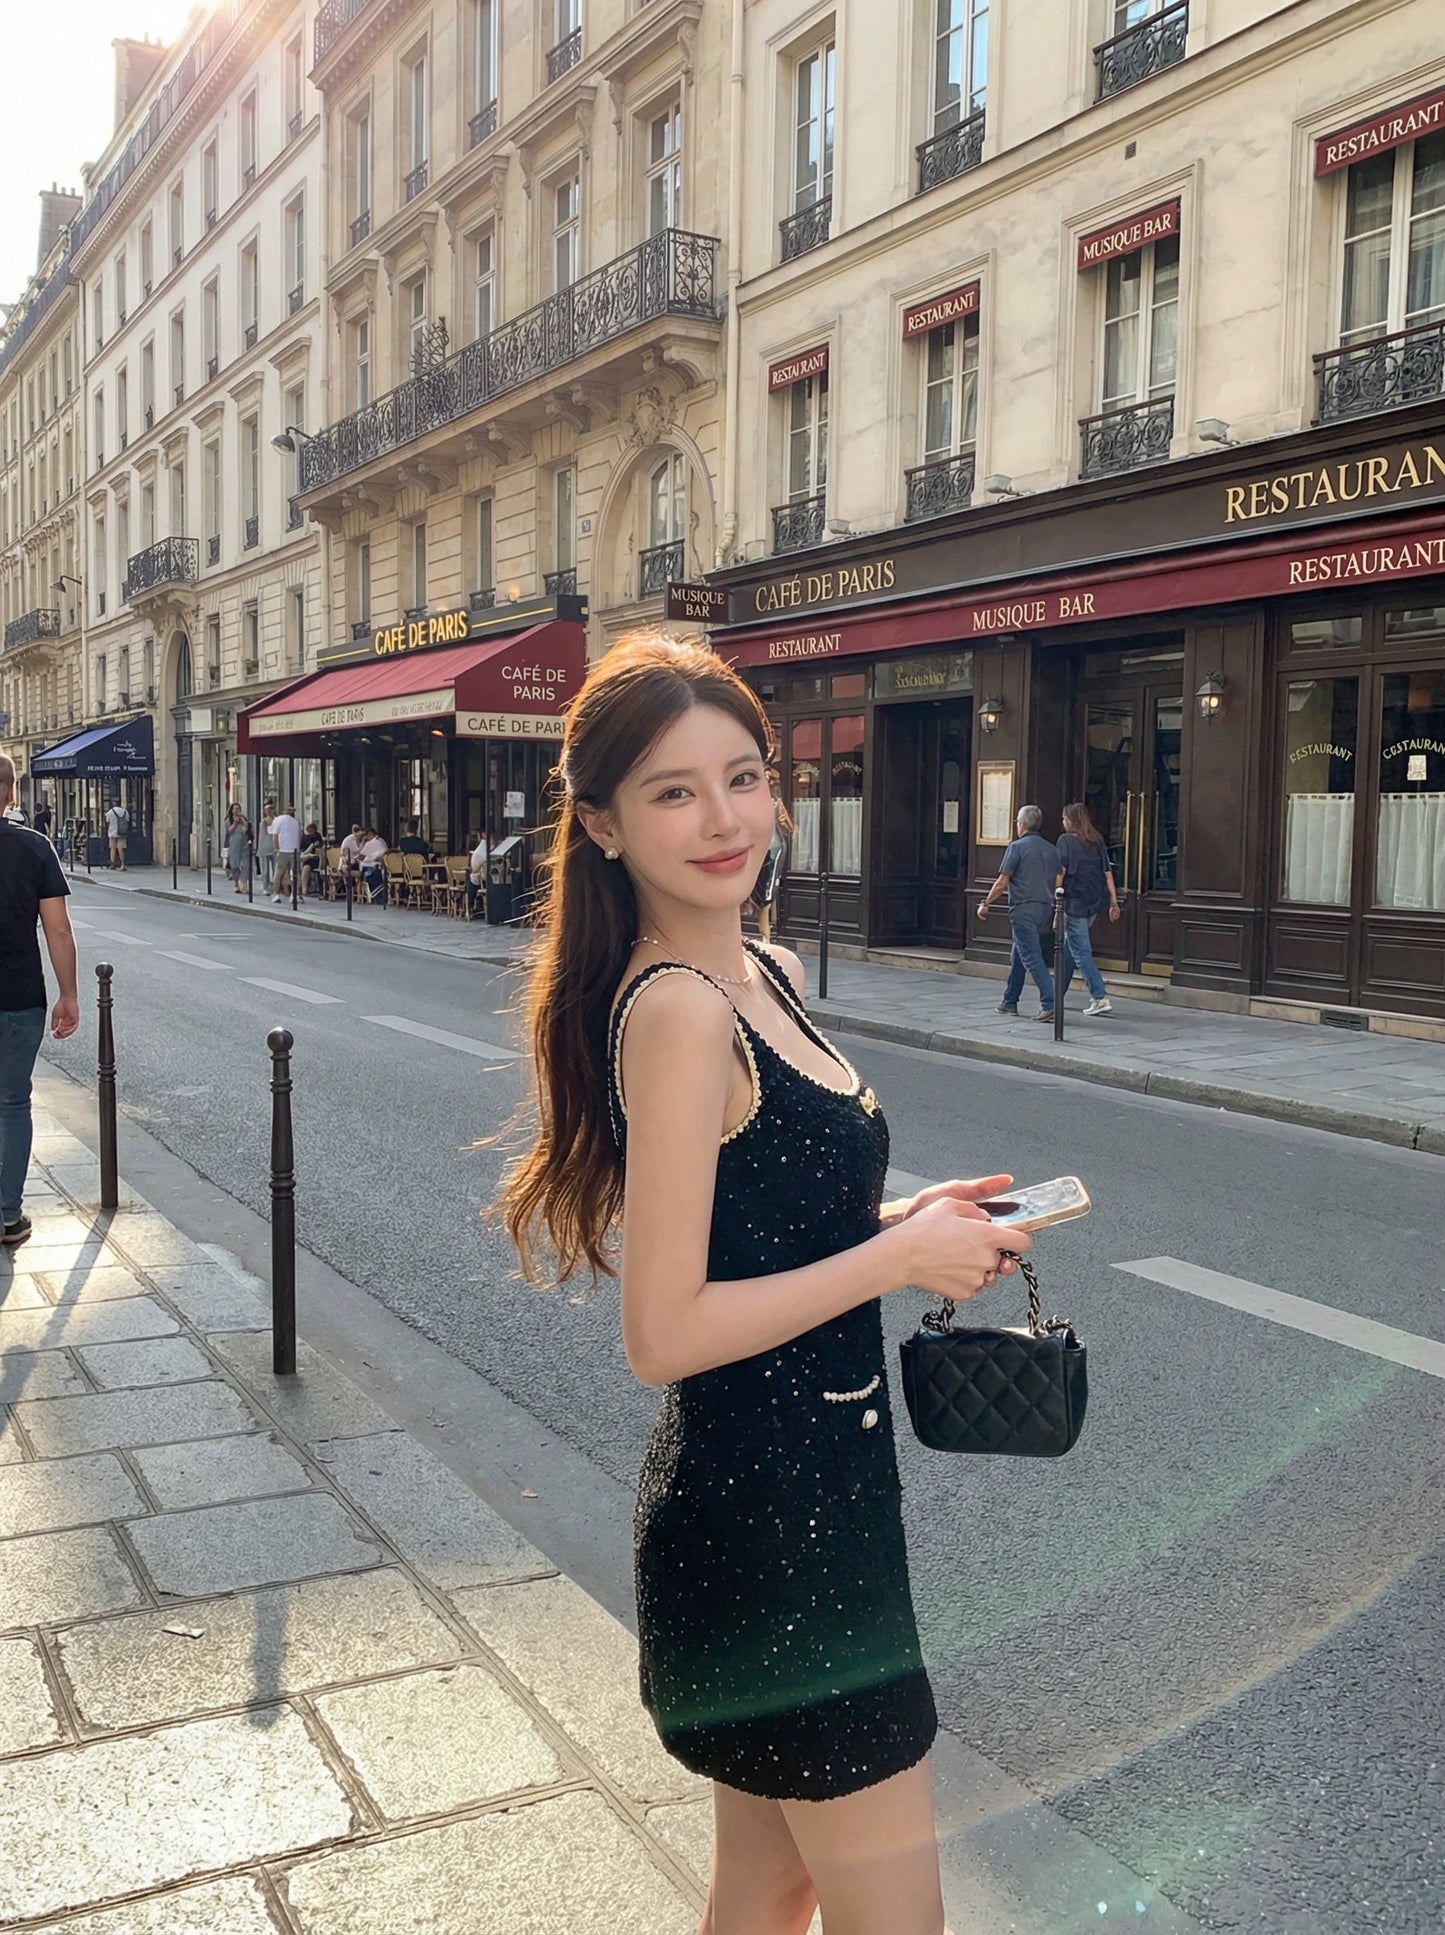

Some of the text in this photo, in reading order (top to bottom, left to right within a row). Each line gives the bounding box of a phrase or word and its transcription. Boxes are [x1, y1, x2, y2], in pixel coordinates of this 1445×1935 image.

[1326, 101, 1444, 165] RESTAURANT
[1083, 213, 1172, 262] MUSIQUE BAR
[908, 291, 975, 332] RESTAURANT
[1288, 539, 1445, 585] RESTAURANT
[671, 587, 725, 605] MUSIQUE
[755, 559, 896, 613] CAFÉ DE PARIS
[685, 603, 711, 618] BAR
[973, 592, 1095, 631] MUSIQUE BAR
[375, 610, 468, 656] CAFÉ DE PARIS
[768, 633, 842, 659] RESTAURANT
[501, 664, 567, 683] CAFÉ DE
[513, 685, 556, 701] PARIS
[467, 715, 566, 734] CAFÉ DE PARI
